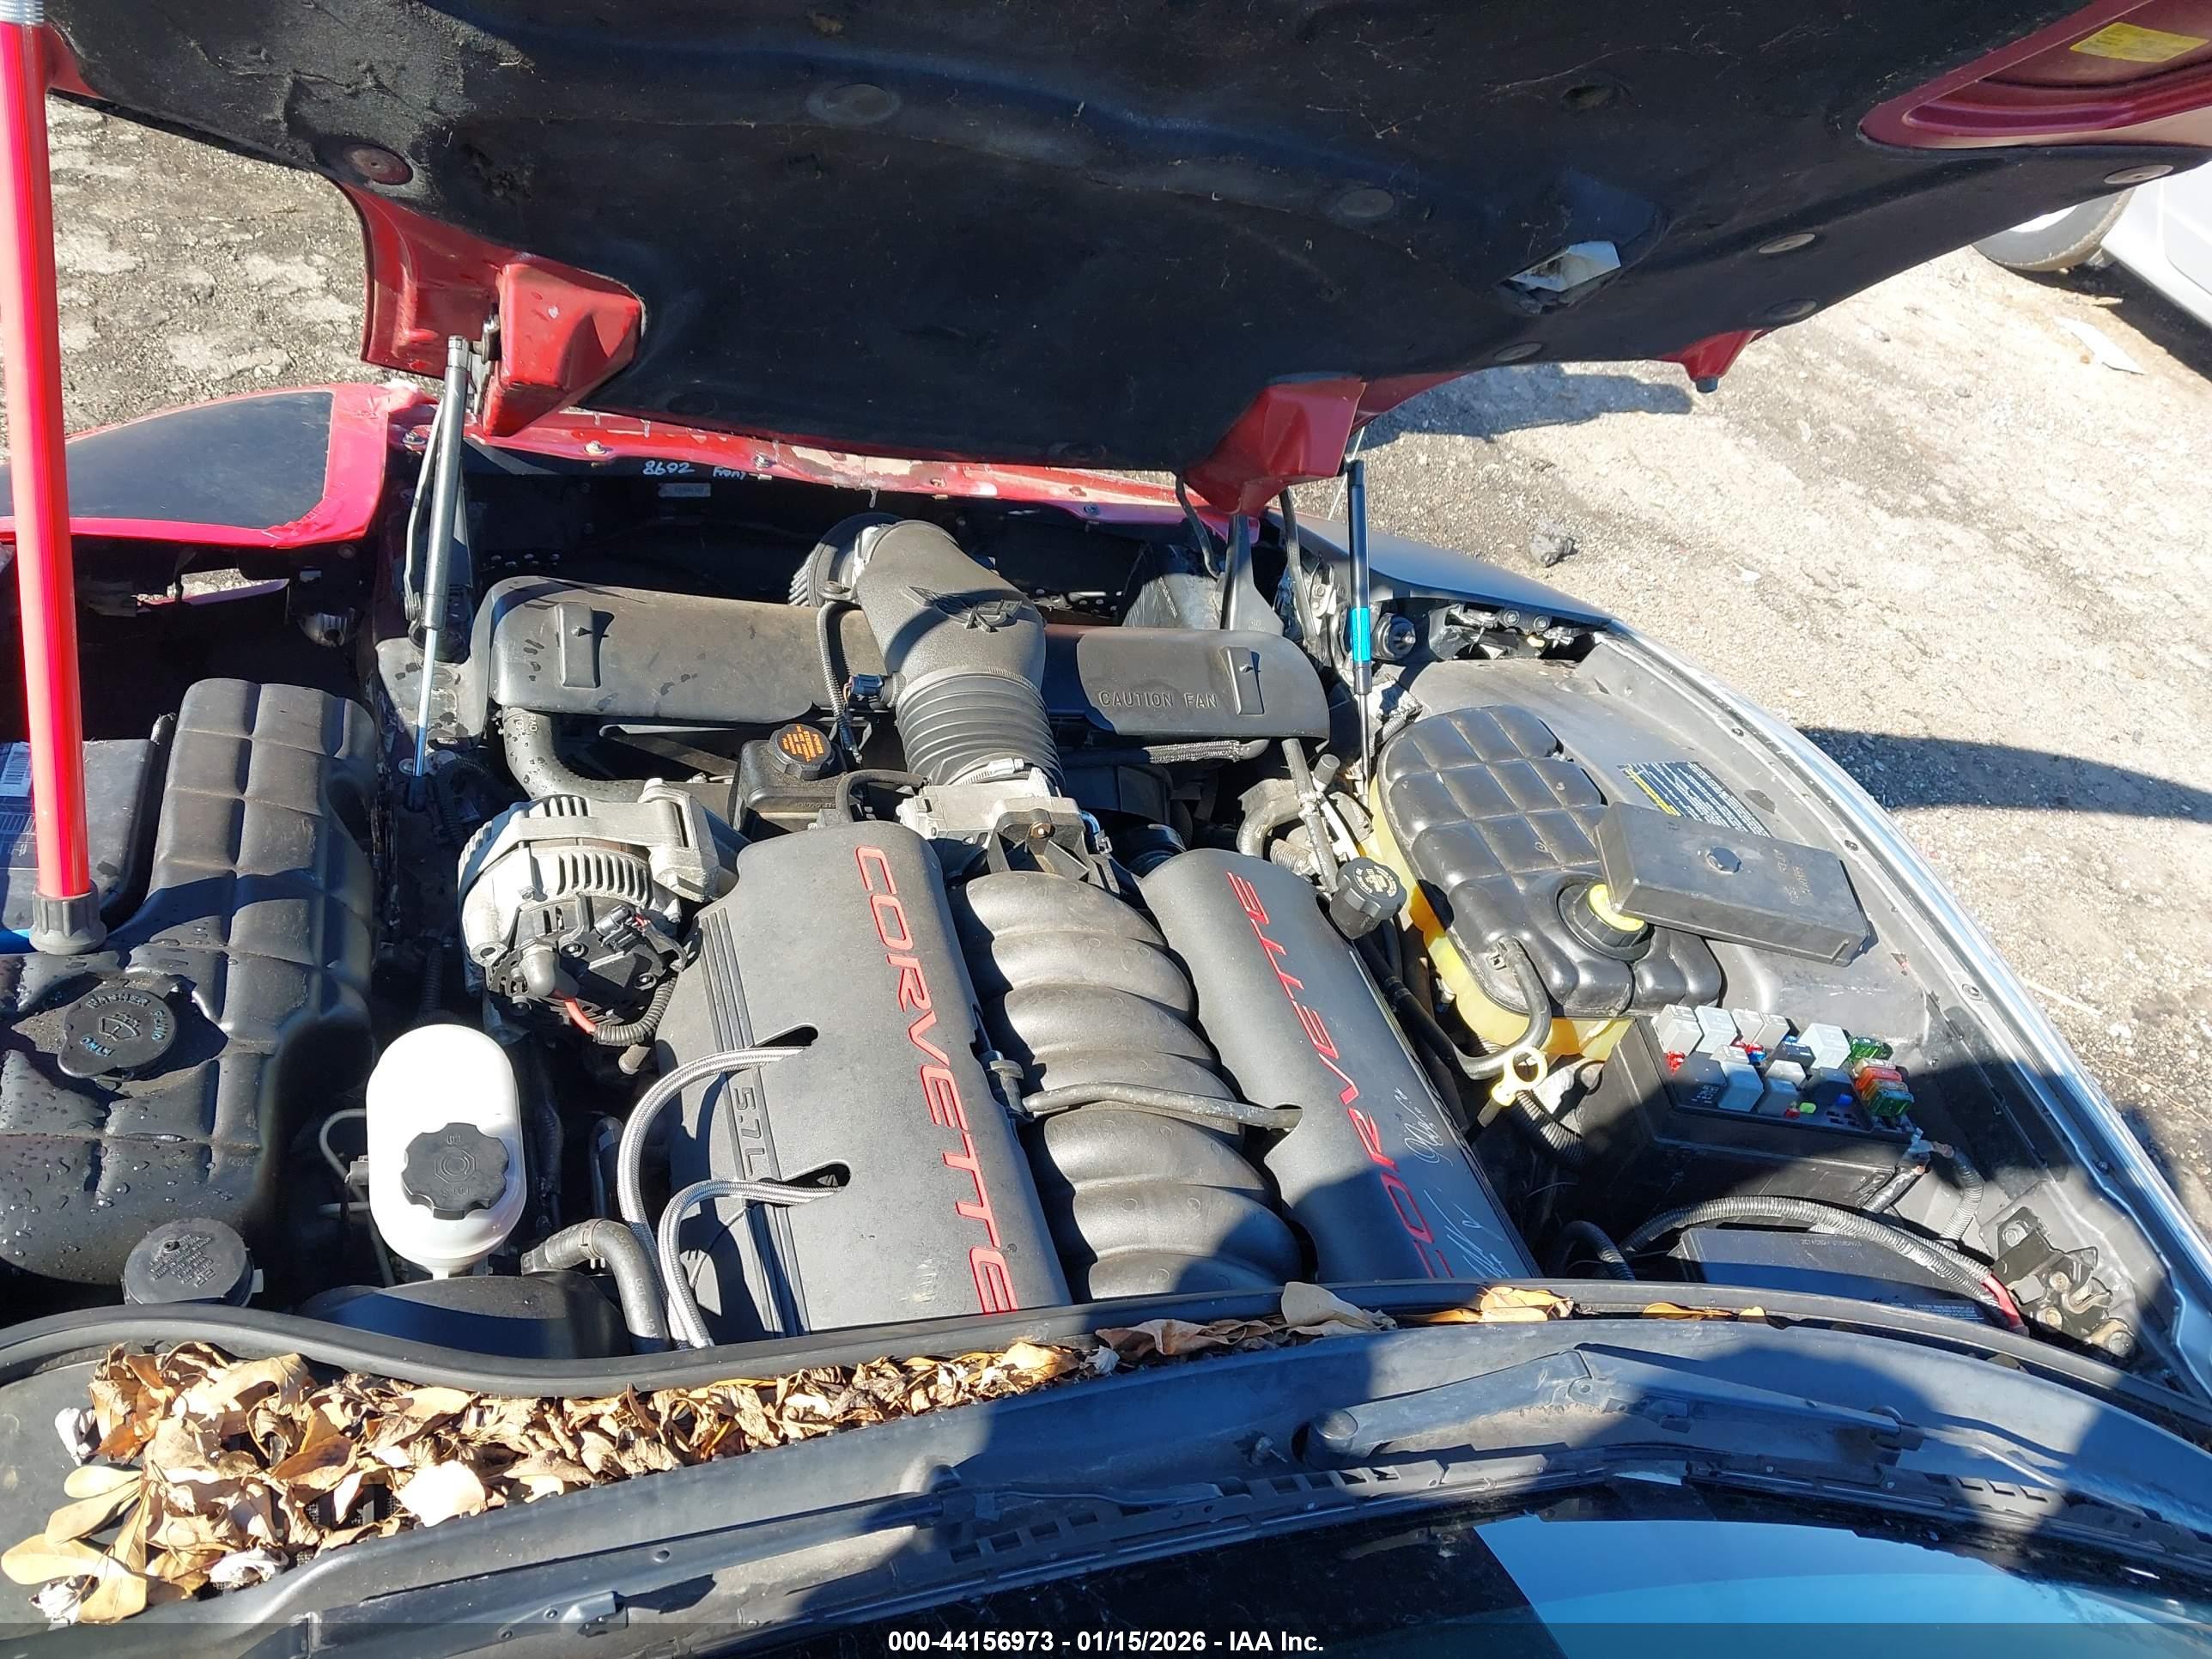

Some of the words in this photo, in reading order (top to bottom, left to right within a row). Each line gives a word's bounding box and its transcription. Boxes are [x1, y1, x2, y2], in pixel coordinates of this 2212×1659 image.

[1099, 690, 1174, 707] CAUTION
[1184, 693, 1218, 708] FAN
[86, 994, 150, 1009] WASHER
[855, 846, 1018, 1315] CORVETTE
[733, 1087, 765, 1176] 5.7L
